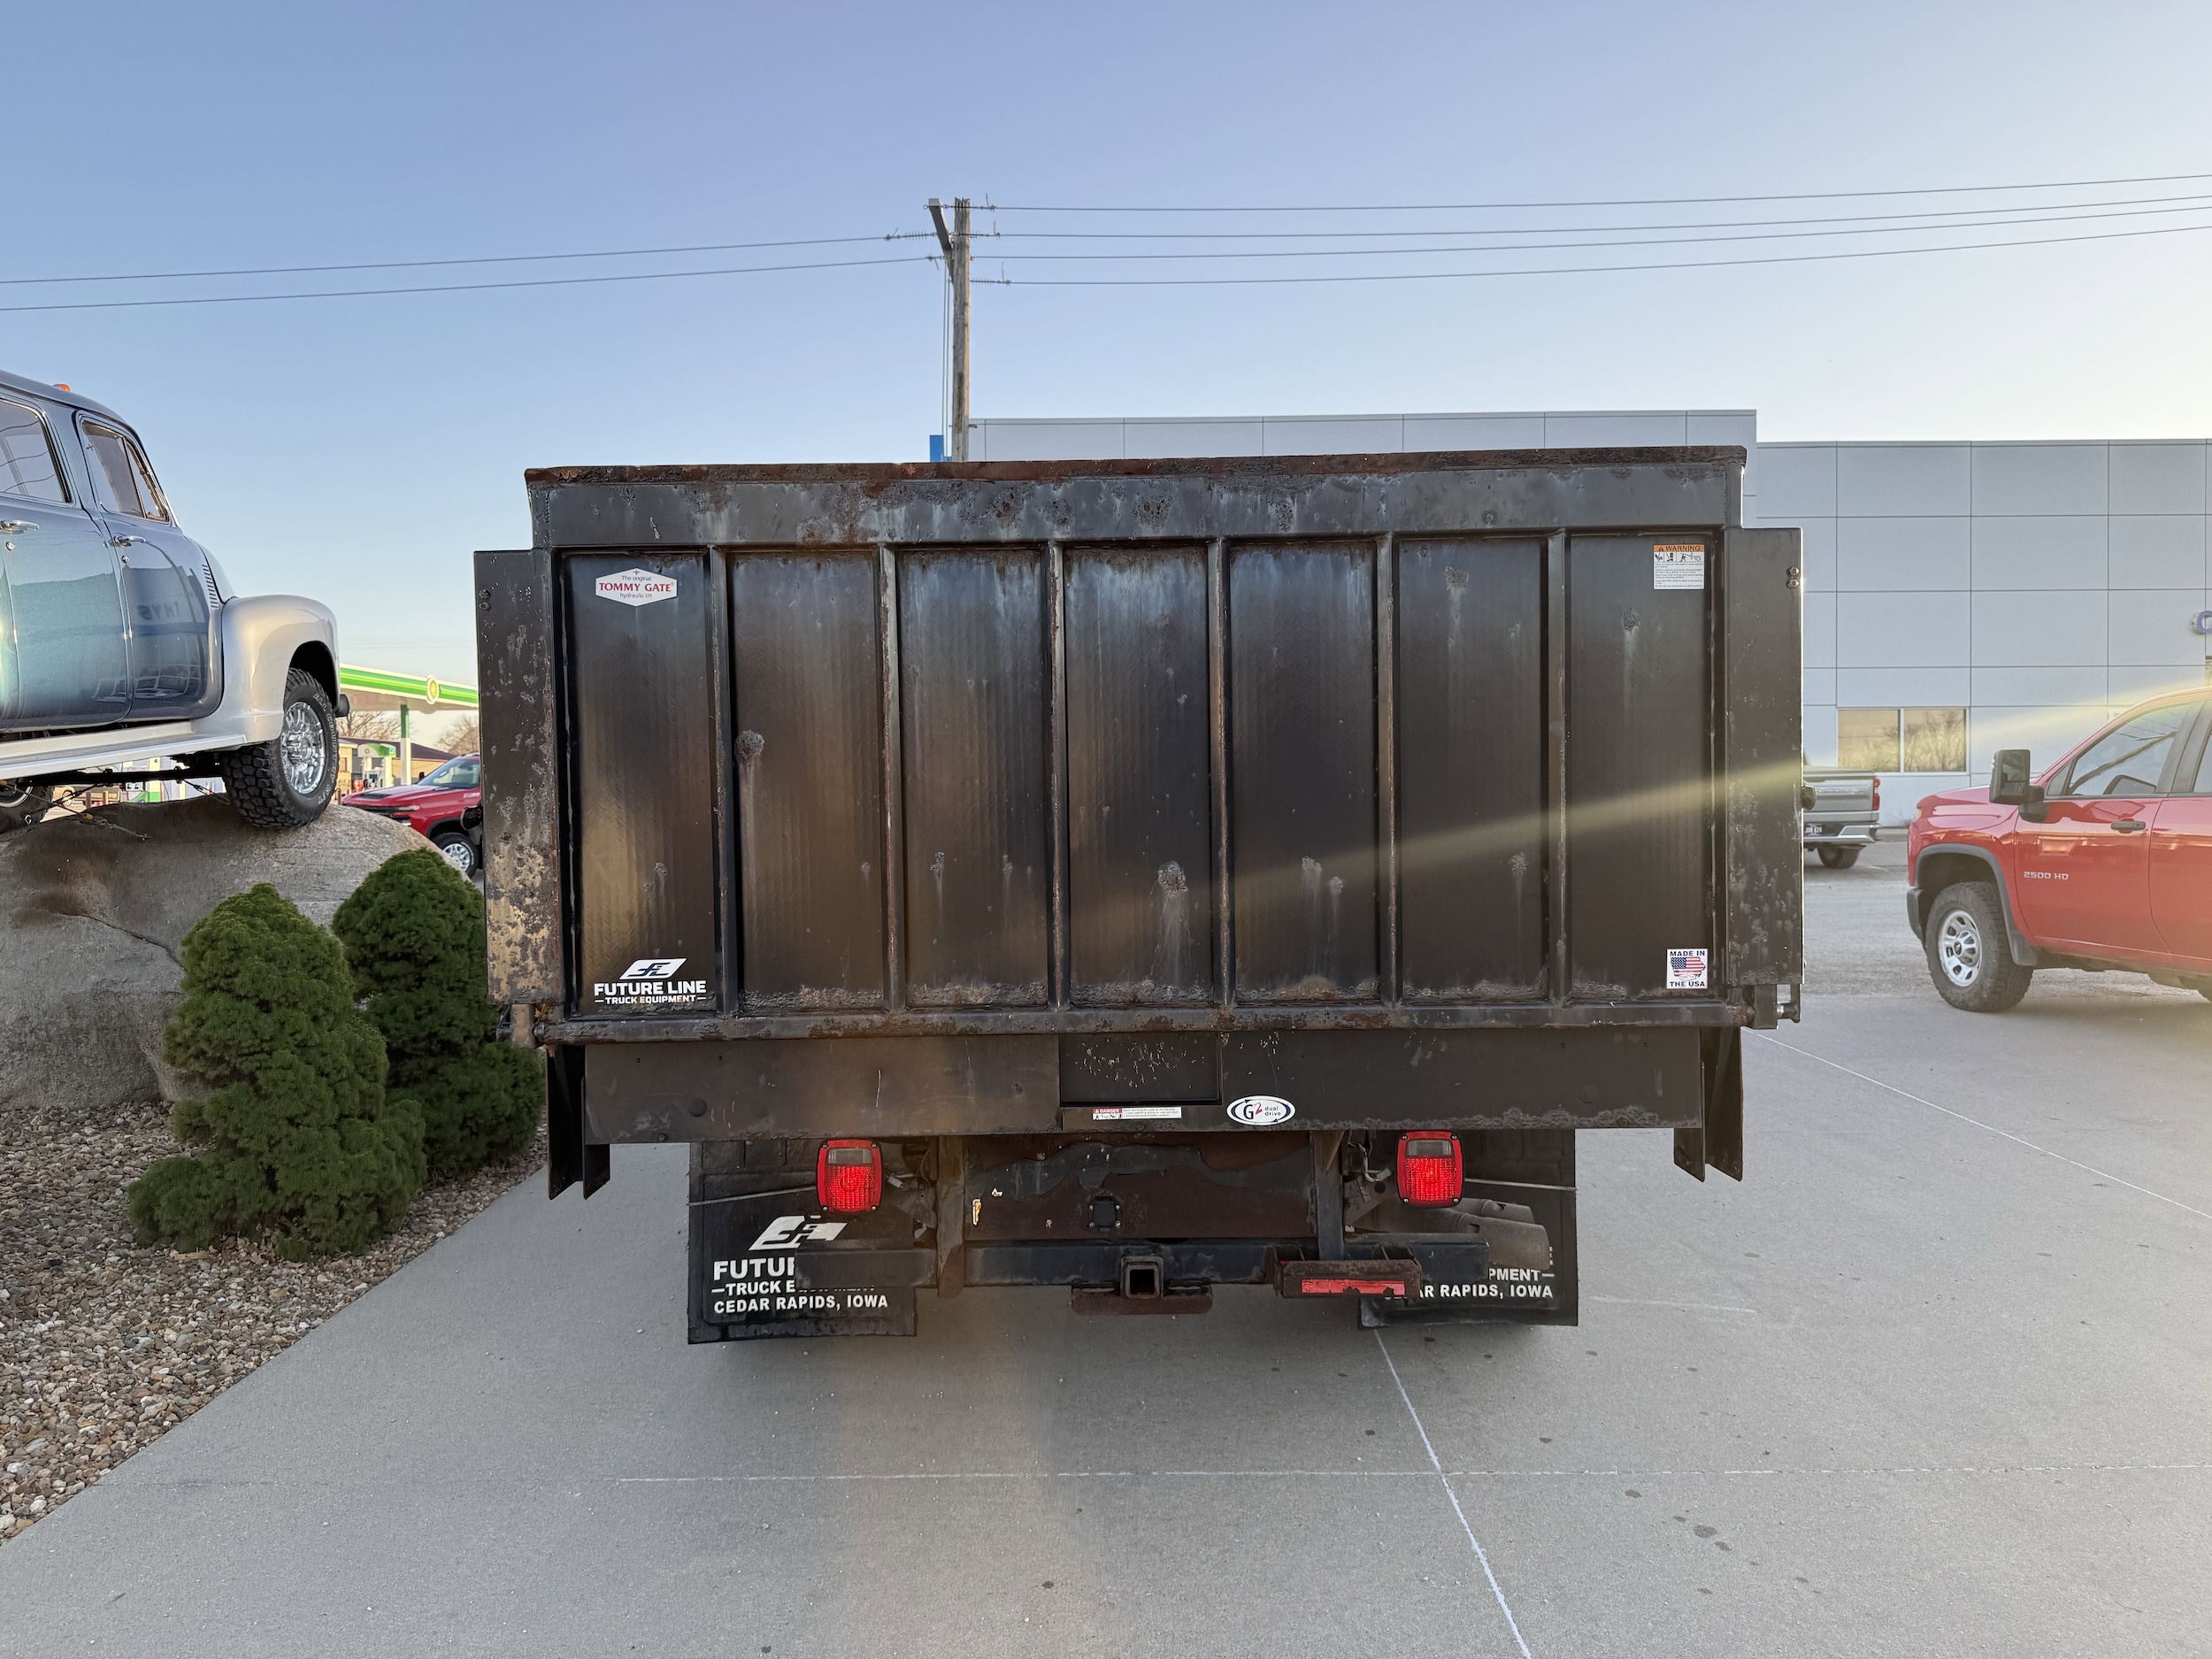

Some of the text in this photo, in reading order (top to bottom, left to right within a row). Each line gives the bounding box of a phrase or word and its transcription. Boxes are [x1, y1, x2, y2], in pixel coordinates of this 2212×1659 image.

[599, 582, 672, 592] TOMMY GATE
[2023, 871, 2052, 879] 2500
[594, 980, 707, 996] FUTURE LINE
[639, 995, 696, 1004] EQUIPMENT
[713, 1256, 795, 1281] FUTU
[1488, 1268, 1541, 1282] PMENT
[726, 1280, 781, 1296] TRUCK
[1440, 1284, 1504, 1300] RAPIDS,
[1509, 1284, 1554, 1298] IOWA
[713, 1294, 888, 1314] CEDAR RAPIDS, IOWA
